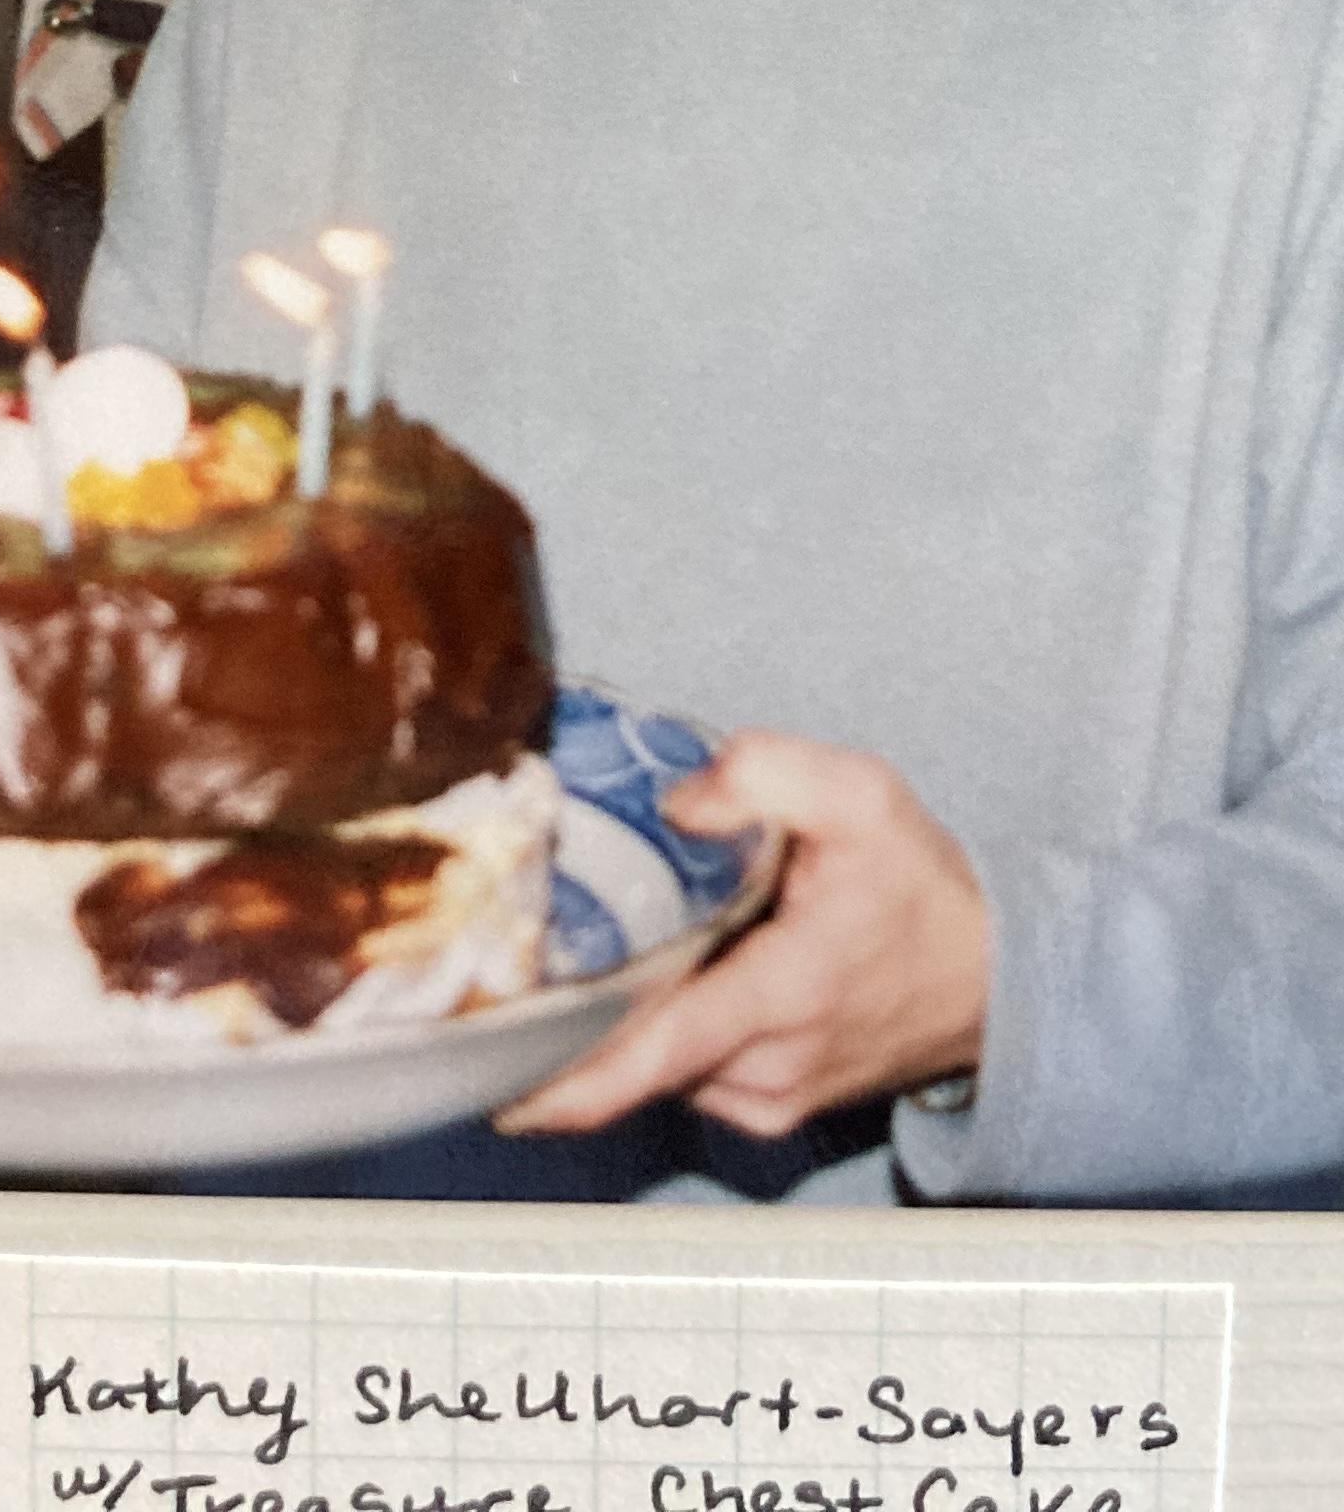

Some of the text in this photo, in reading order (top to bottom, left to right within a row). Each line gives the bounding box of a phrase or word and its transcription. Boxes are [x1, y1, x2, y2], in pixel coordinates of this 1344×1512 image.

[30, 1356, 1179, 1478] Kathy Shellhart-Sayers
[650, 1464, 884, 1512] Chest
